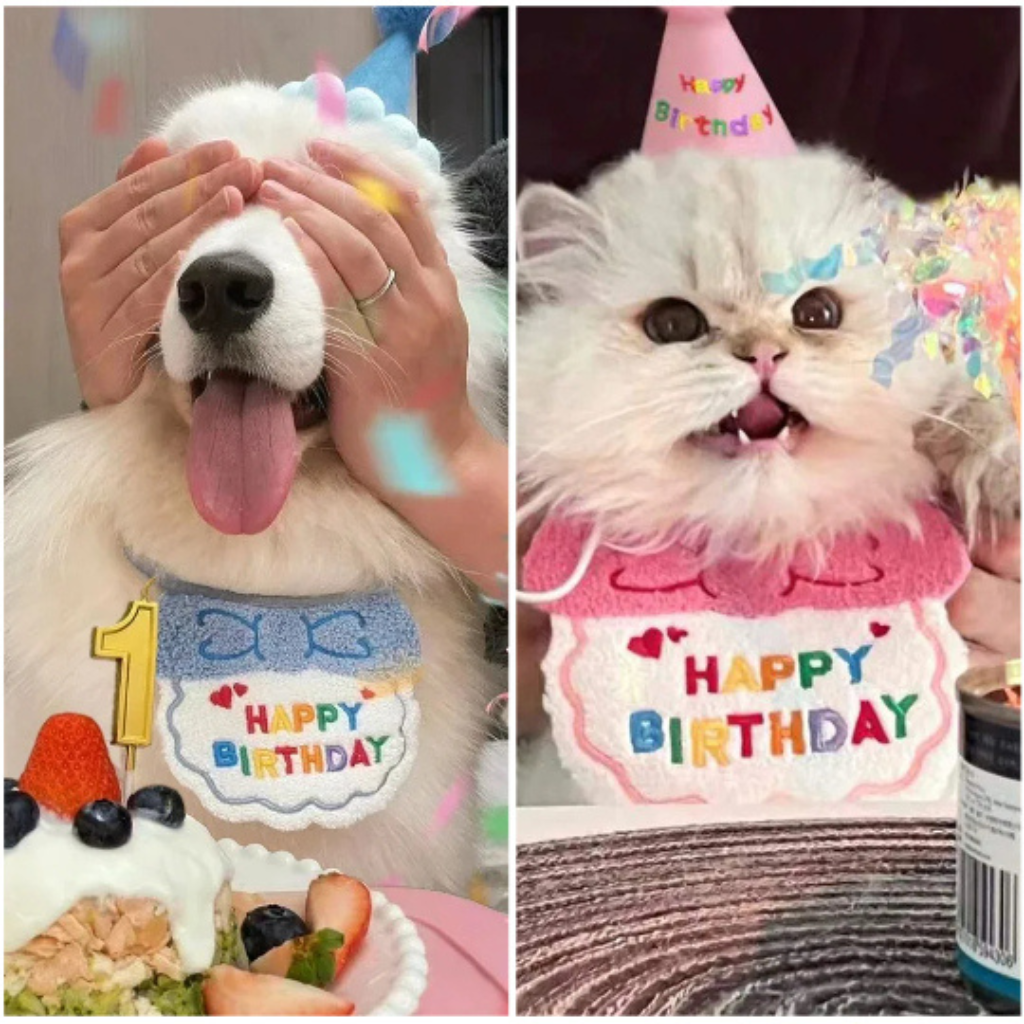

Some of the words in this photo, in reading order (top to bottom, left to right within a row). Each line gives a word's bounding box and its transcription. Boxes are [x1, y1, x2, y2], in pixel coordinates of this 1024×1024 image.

[678, 73, 746, 94] Happy
[685, 644, 874, 696] HAPPY
[245, 702, 364, 735] HAPPY
[628, 693, 919, 768] BIRTHDAY
[212, 735, 390, 780] BIRTHDAY
